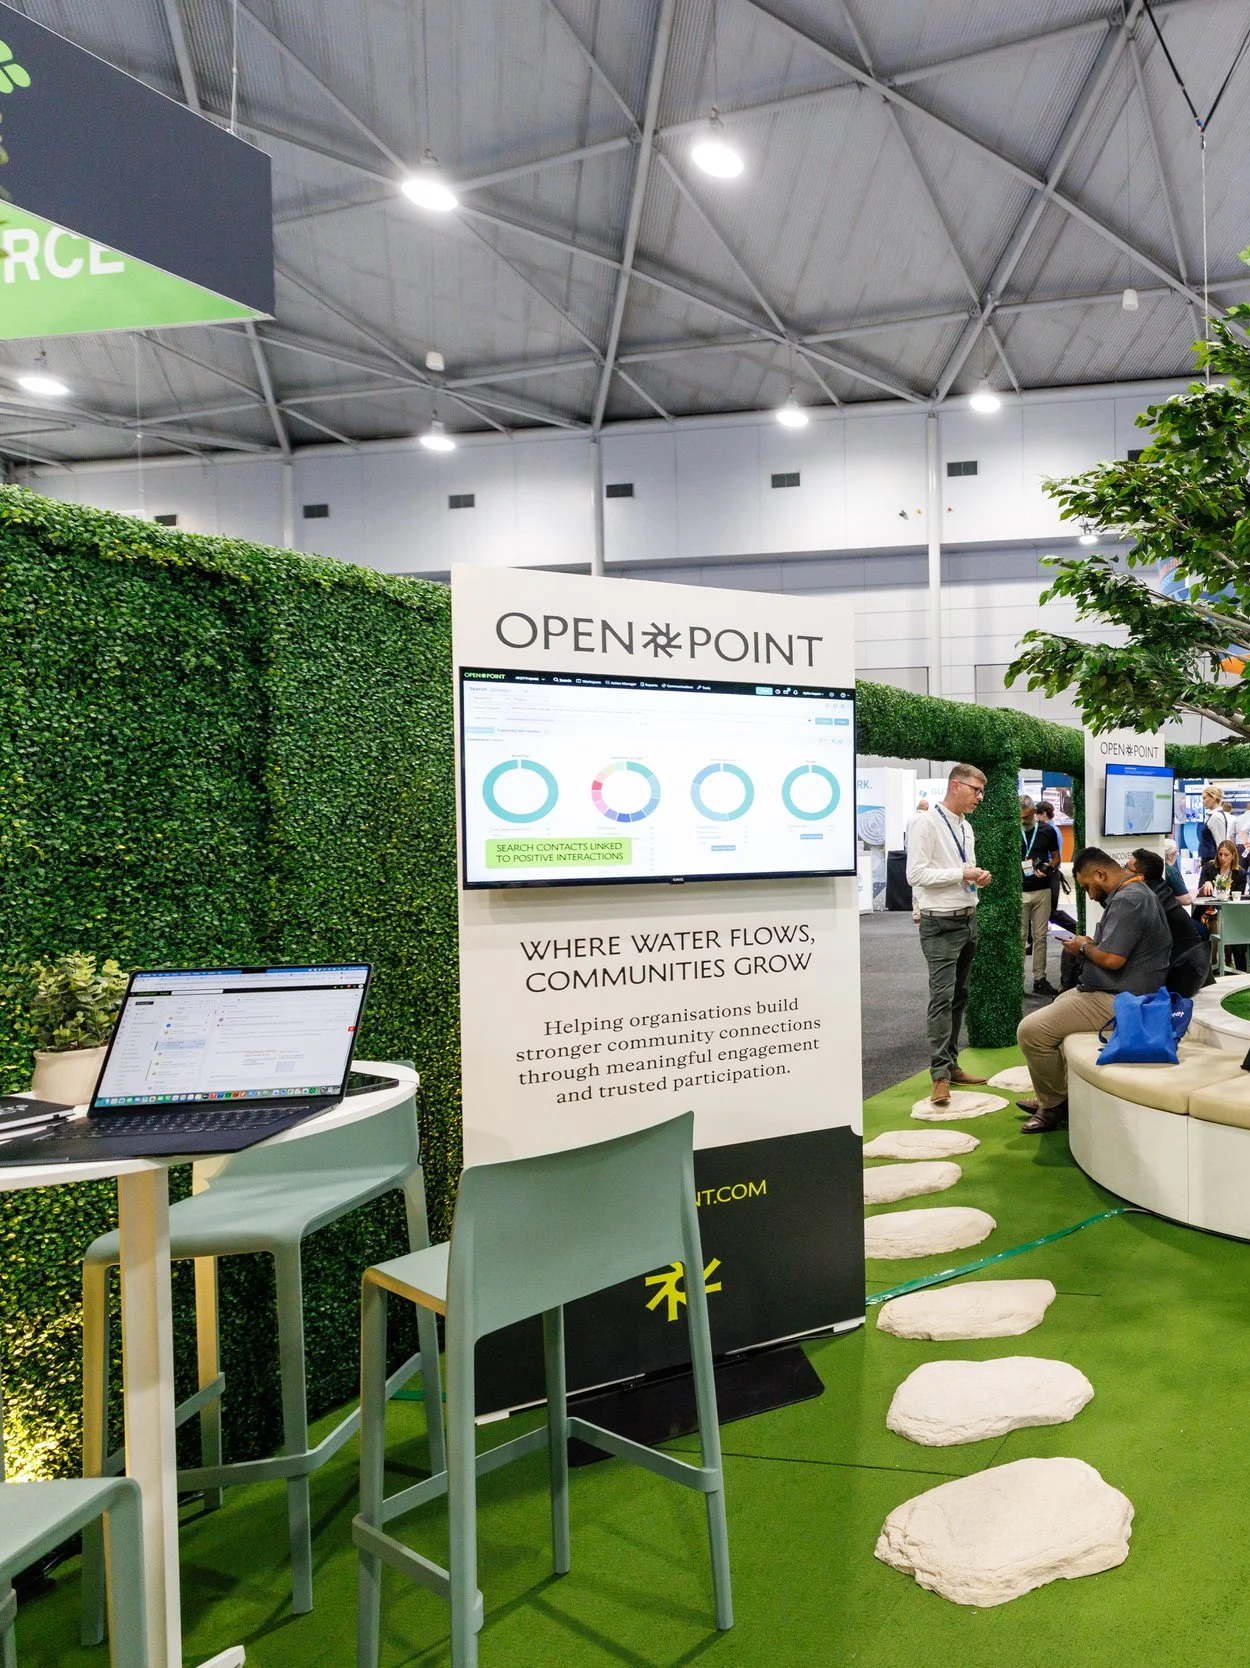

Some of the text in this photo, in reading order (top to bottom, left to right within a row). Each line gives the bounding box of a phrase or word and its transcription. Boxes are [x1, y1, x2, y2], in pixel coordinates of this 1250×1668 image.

[496, 842, 623, 853] SEARCH CONTACTS LINKED
[496, 853, 624, 863] TO POSITIVE INTERACTIONS
[520, 924, 816, 961] WHERE WATER FLOWS,
[525, 952, 813, 993] COMMUNITIES GROW
[544, 998, 799, 1038] Helping organisations build
[515, 1018, 822, 1063] stronger community connections
[519, 1037, 820, 1087] through meaningful engagement
[556, 1064, 791, 1104] and trusted participation.
